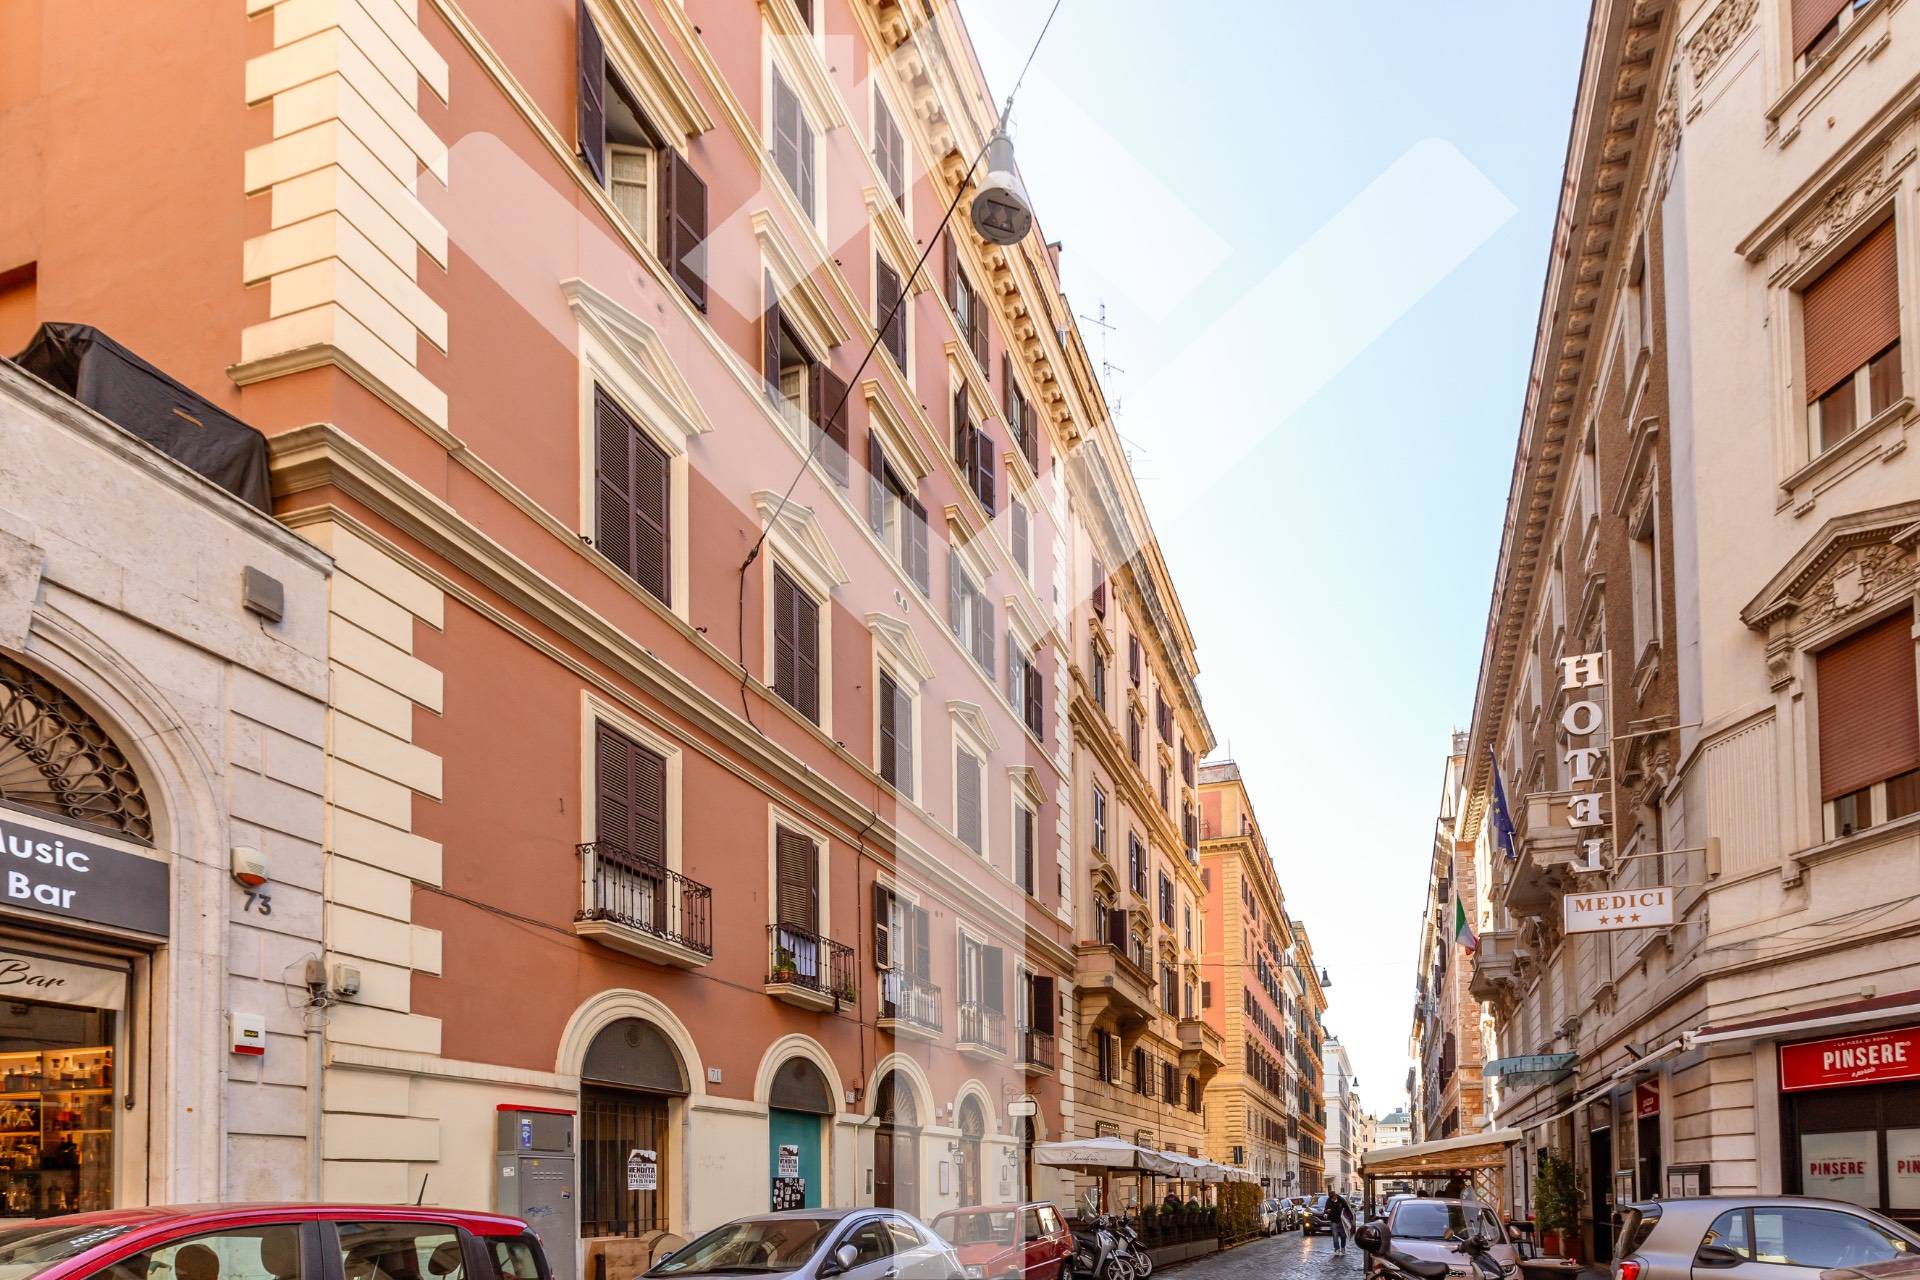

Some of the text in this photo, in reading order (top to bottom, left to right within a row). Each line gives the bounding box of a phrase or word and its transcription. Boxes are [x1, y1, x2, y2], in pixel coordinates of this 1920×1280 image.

[8, 870, 76, 909] Bar
[243, 890, 272, 915] 73
[1575, 892, 1664, 912] MEDICI
[0, 959, 67, 988] Bar
[1823, 1041, 1908, 1071] PINSERE
[1810, 1161, 1865, 1175] PINSERE
